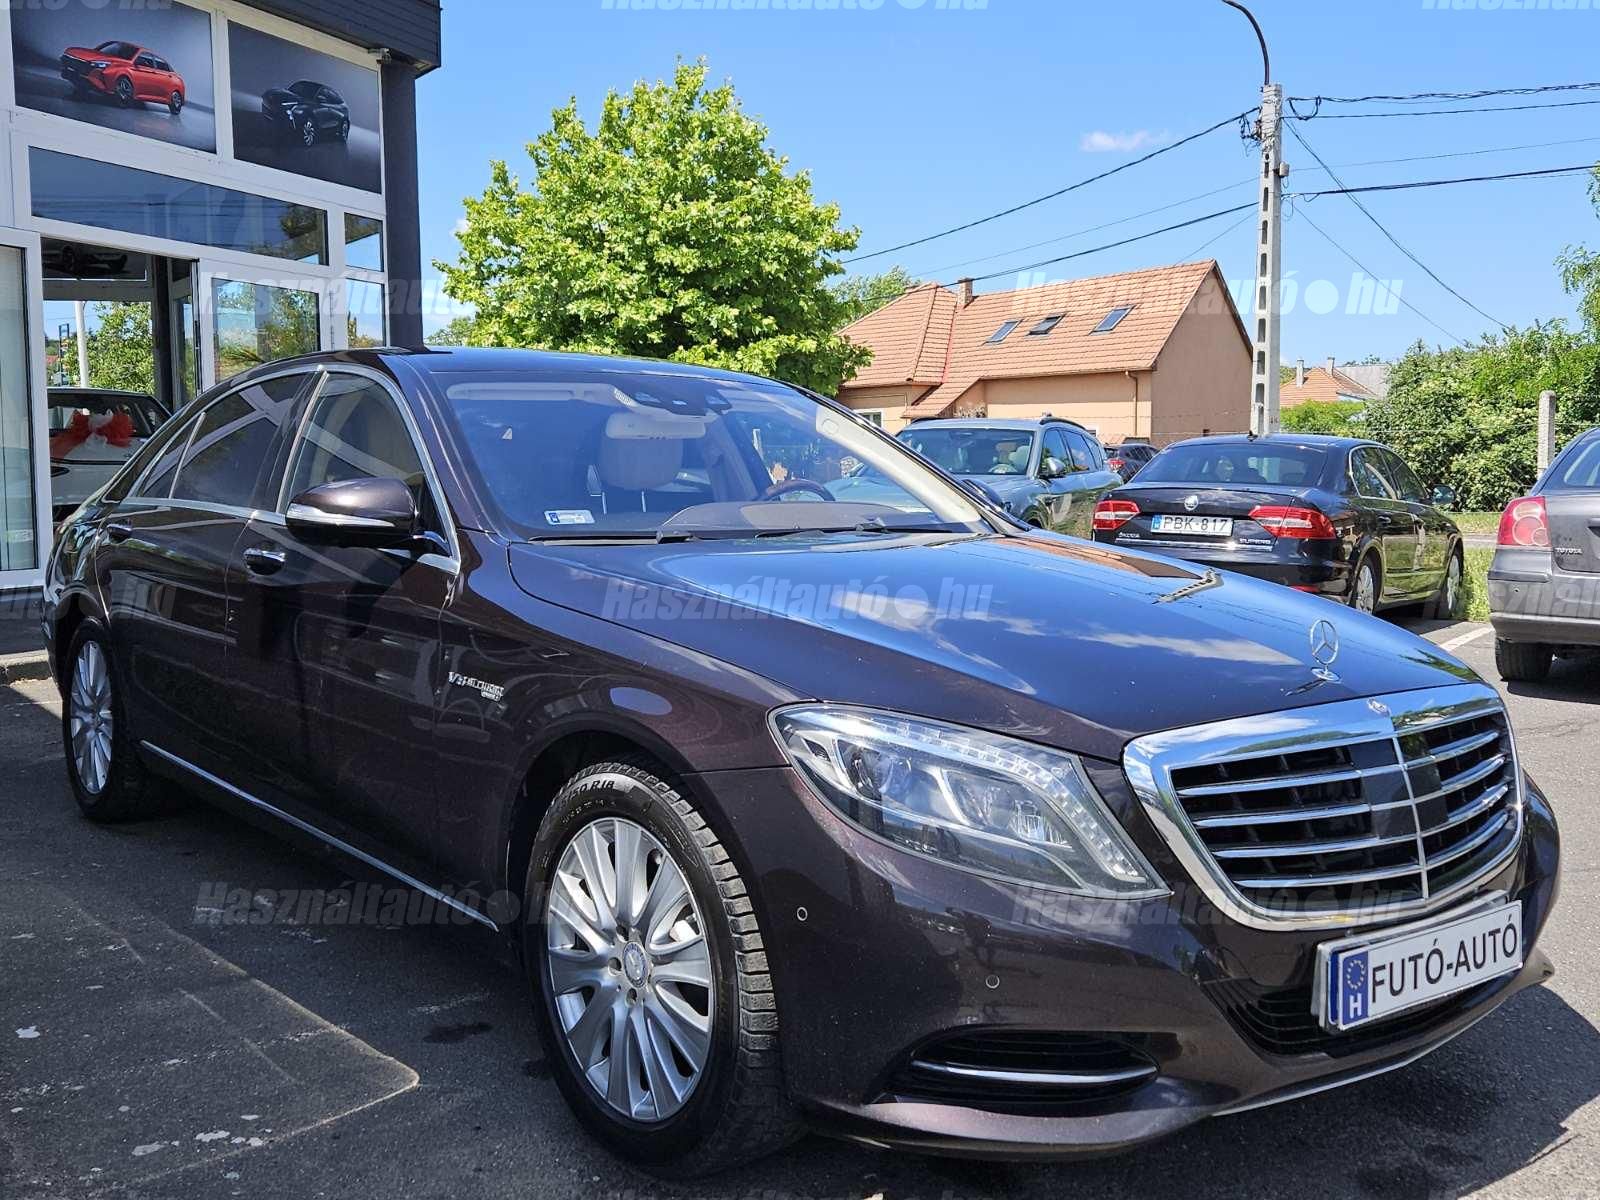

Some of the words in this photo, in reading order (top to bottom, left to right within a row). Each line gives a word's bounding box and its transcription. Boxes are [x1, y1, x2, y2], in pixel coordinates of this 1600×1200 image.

[1163, 516, 1229, 531] PBK-817
[1371, 913, 1518, 1003] FUTÓ-AUTÓ
[1349, 992, 1362, 1019] H
